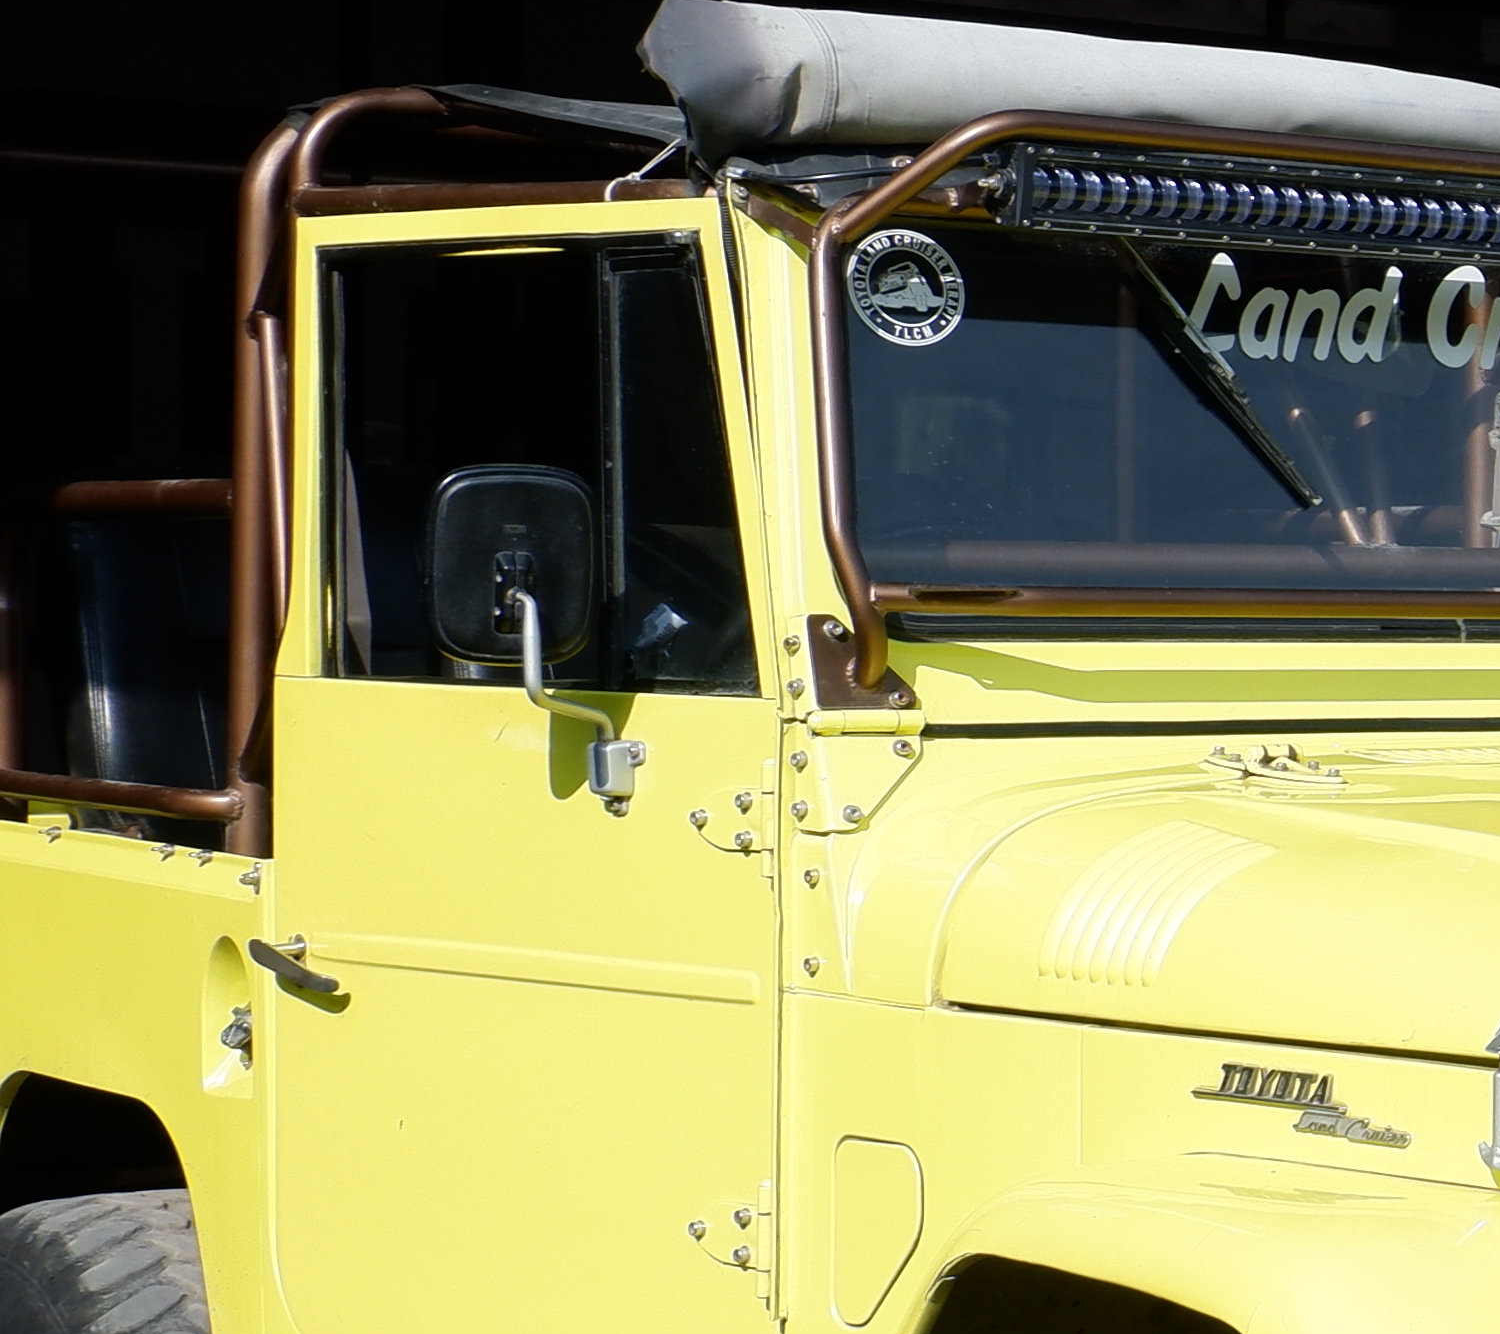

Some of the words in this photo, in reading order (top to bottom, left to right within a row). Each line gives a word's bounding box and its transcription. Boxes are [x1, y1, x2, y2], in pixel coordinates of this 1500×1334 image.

[1189, 252, 1402, 363] Land
[893, 325, 934, 340] TLCM
[1218, 1062, 1335, 1105] TOYOTA
